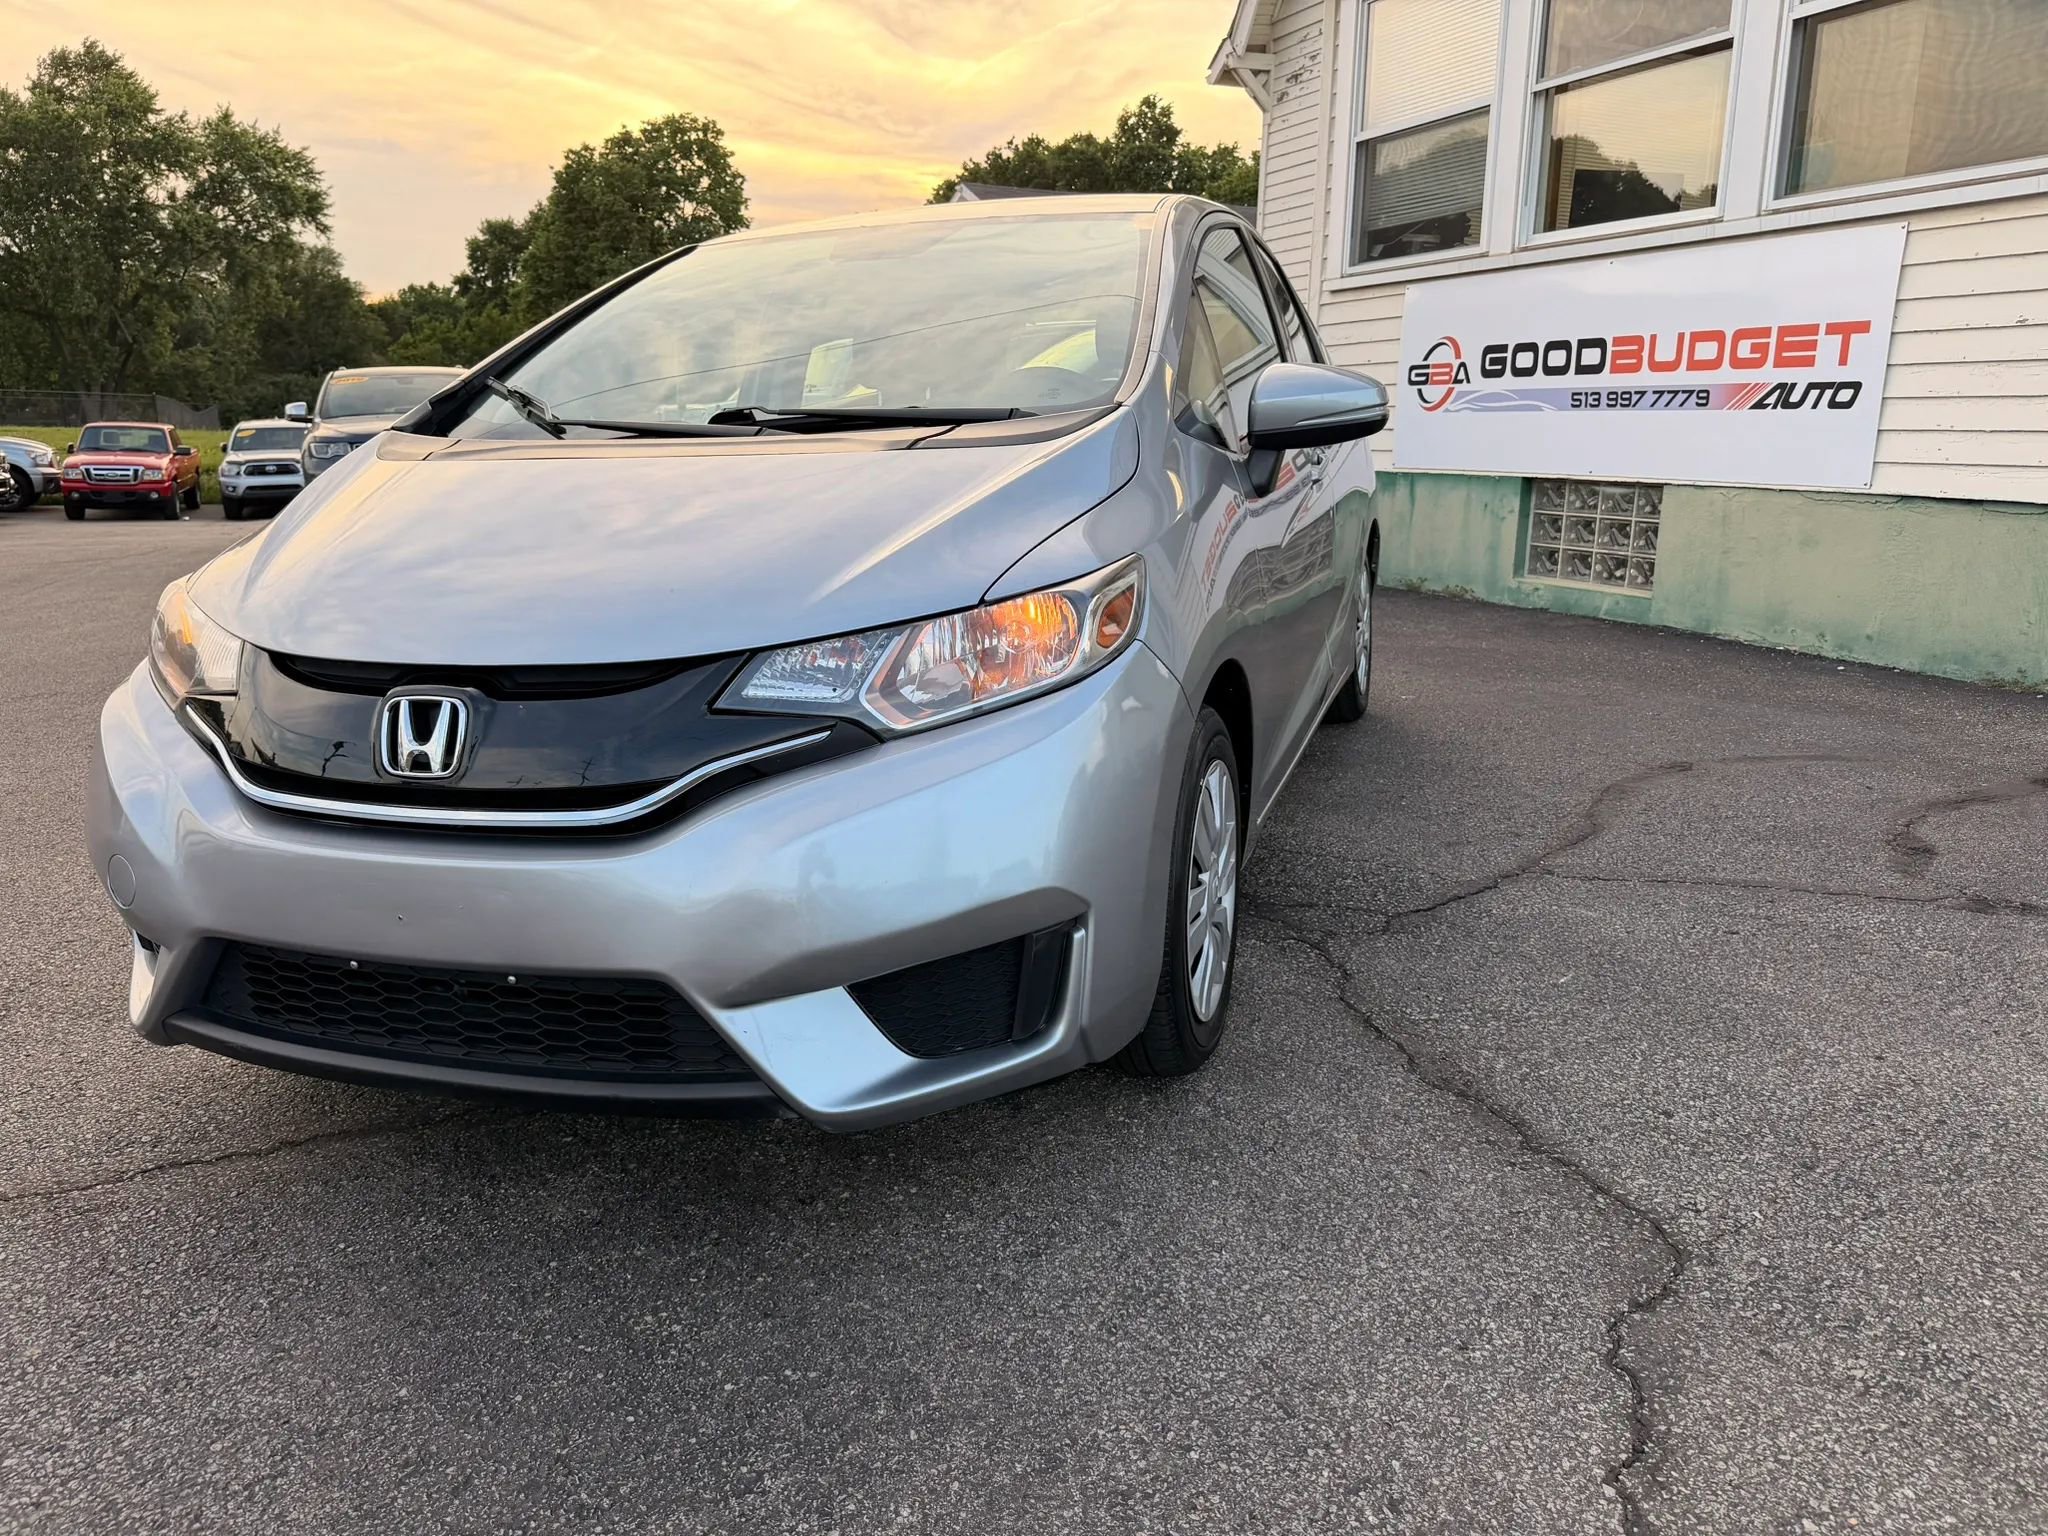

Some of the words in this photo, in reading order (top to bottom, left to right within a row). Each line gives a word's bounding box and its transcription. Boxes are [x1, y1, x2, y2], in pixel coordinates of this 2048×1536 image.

[1408, 361, 1471, 386] GBA
[1570, 391, 1601, 408] 513
[1606, 390, 1648, 408] 997
[1649, 389, 1711, 408] 7779
[1748, 381, 1862, 410] AUTO
